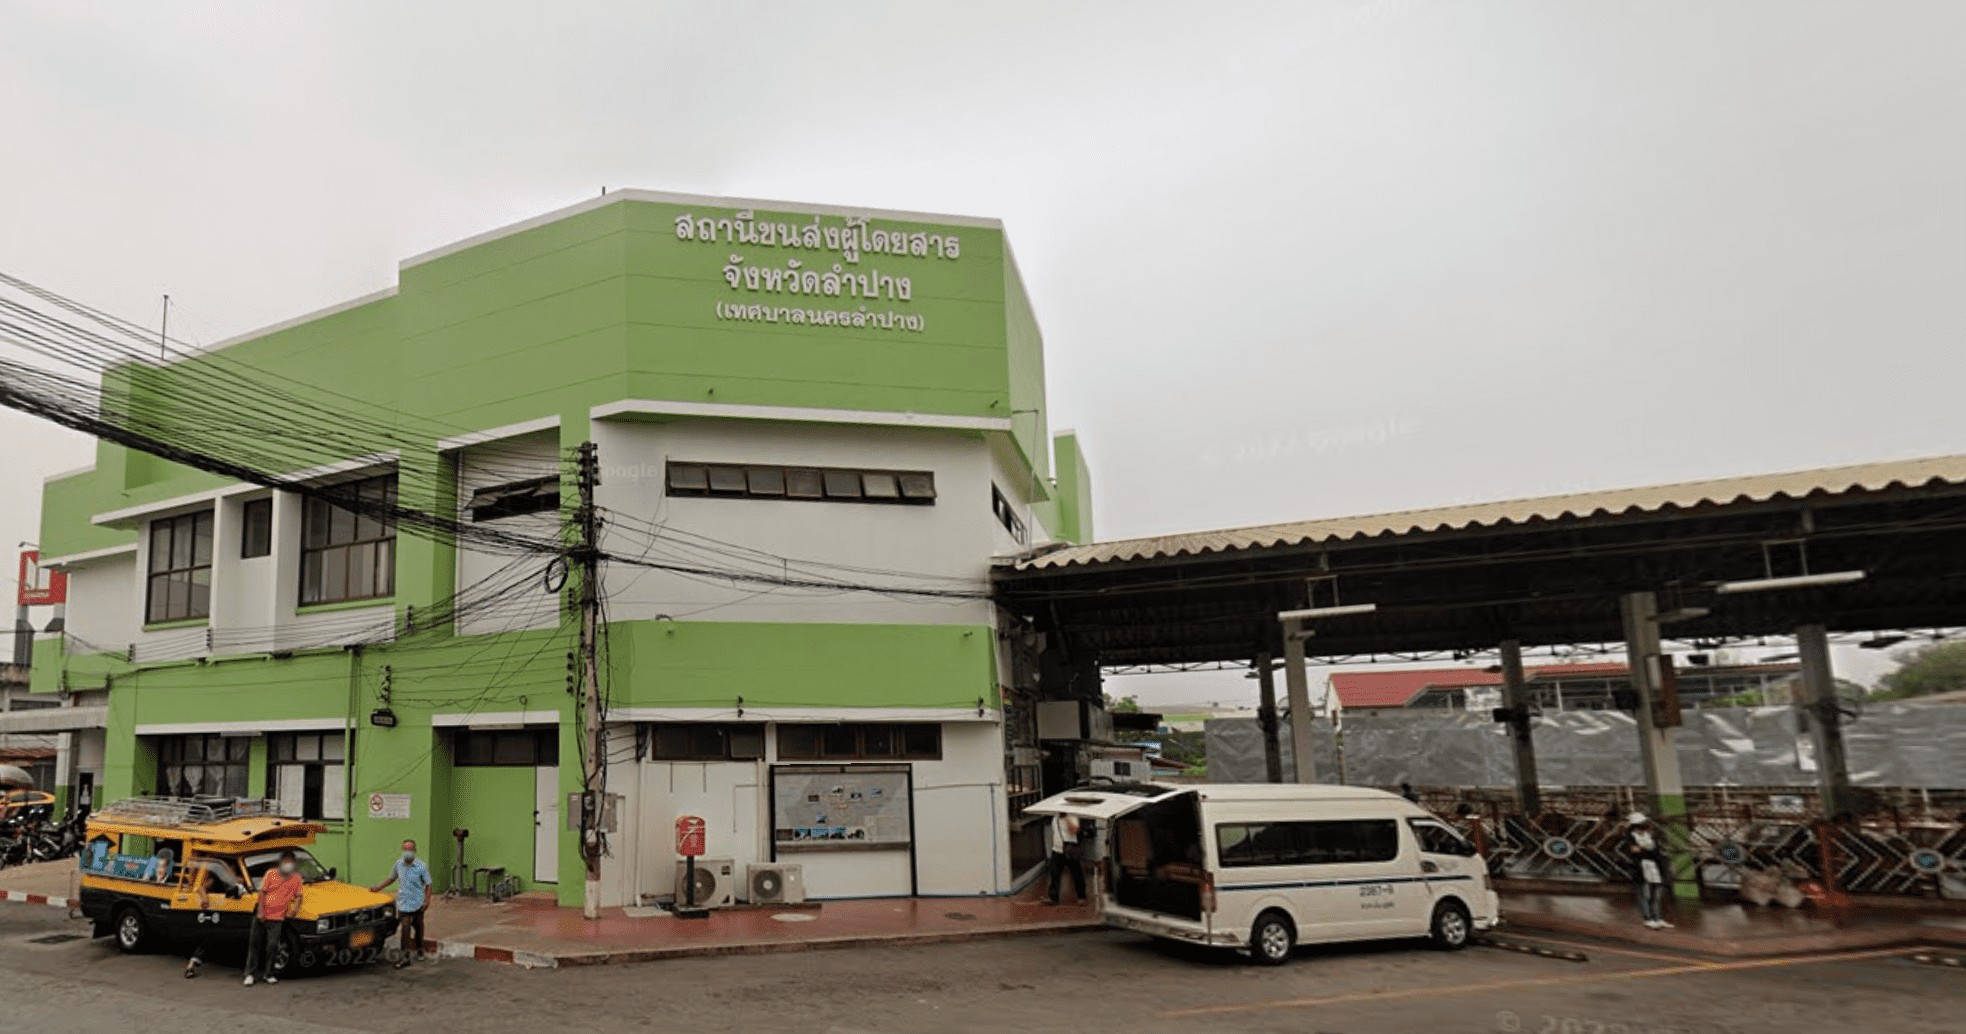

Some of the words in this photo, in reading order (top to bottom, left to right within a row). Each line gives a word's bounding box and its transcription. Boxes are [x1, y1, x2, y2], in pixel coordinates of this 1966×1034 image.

[675, 209, 961, 263] สถานีขนส่งผู้โดยสาร
[723, 254, 912, 300] จังหวัดลำปาง
[716, 301, 925, 332] (เทศบาลนครลำปาง)
